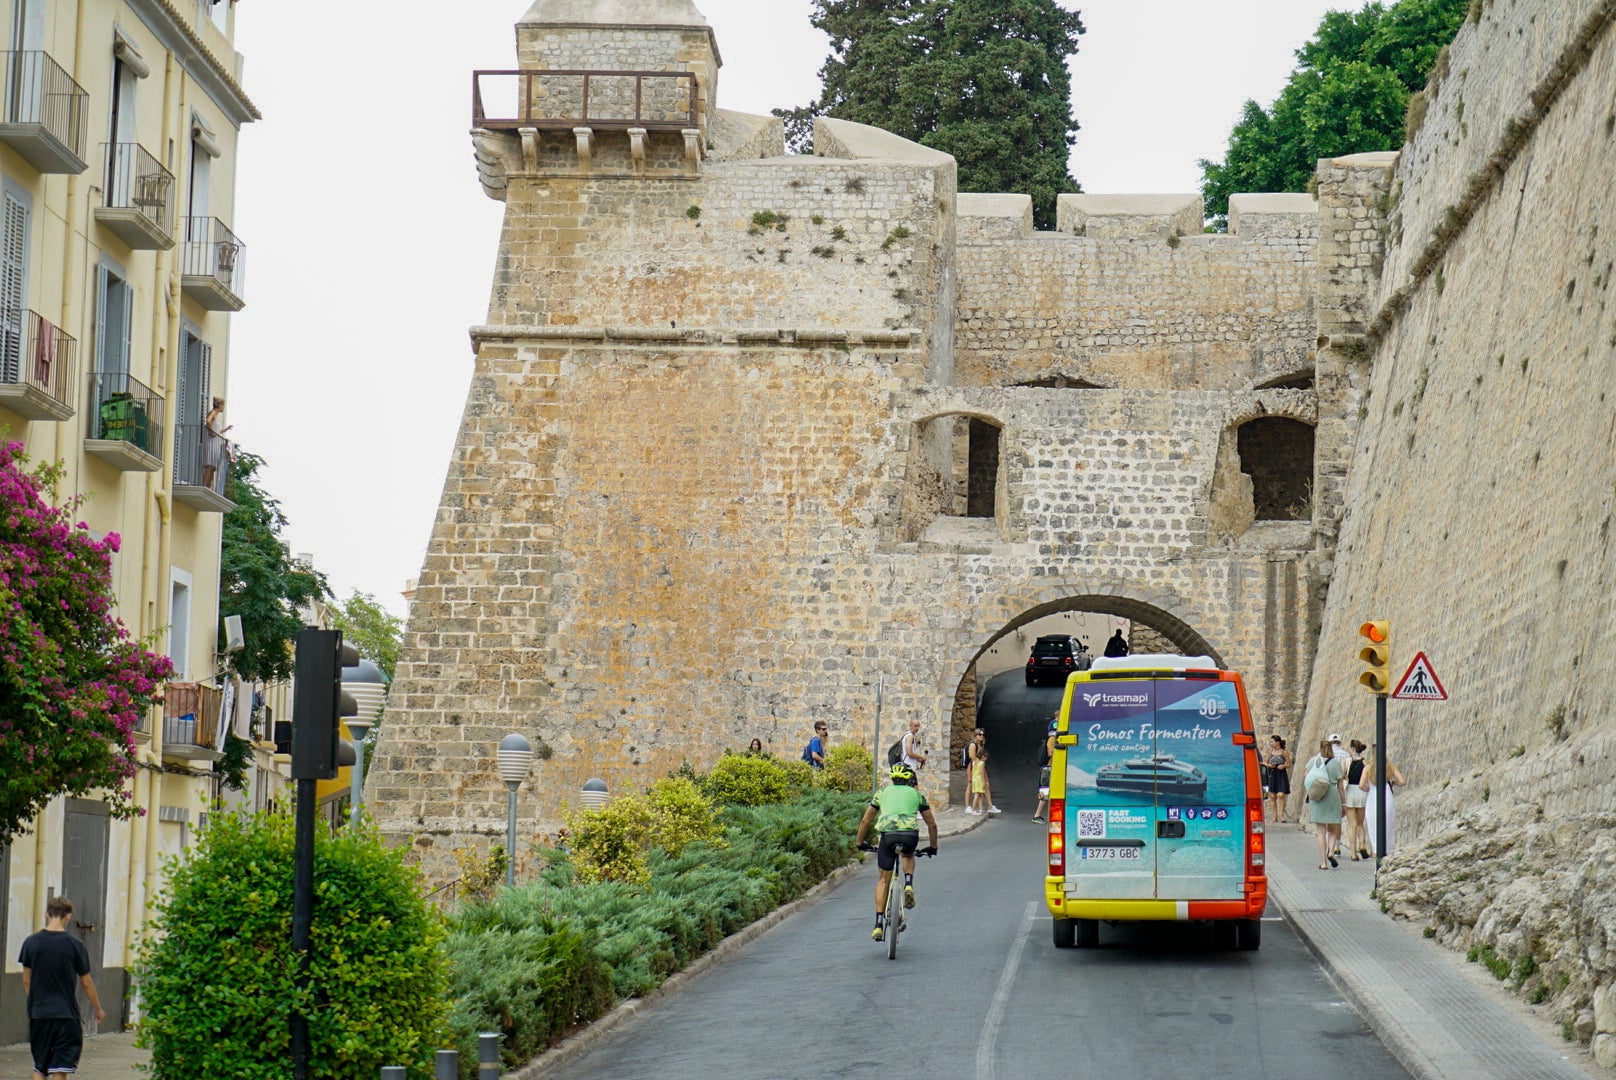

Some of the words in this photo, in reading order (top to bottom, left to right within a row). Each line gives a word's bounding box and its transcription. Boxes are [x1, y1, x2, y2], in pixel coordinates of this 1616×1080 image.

[1102, 692, 1148, 703] trasmapi
[1199, 698, 1216, 716] 30
[1088, 723, 1134, 741] Somos
[1139, 723, 1222, 741] Formentera
[1099, 743, 1119, 752] años
[1121, 744, 1150, 753] contigo
[1089, 848, 1115, 858] 3773
[1119, 848, 1138, 859] GBC
